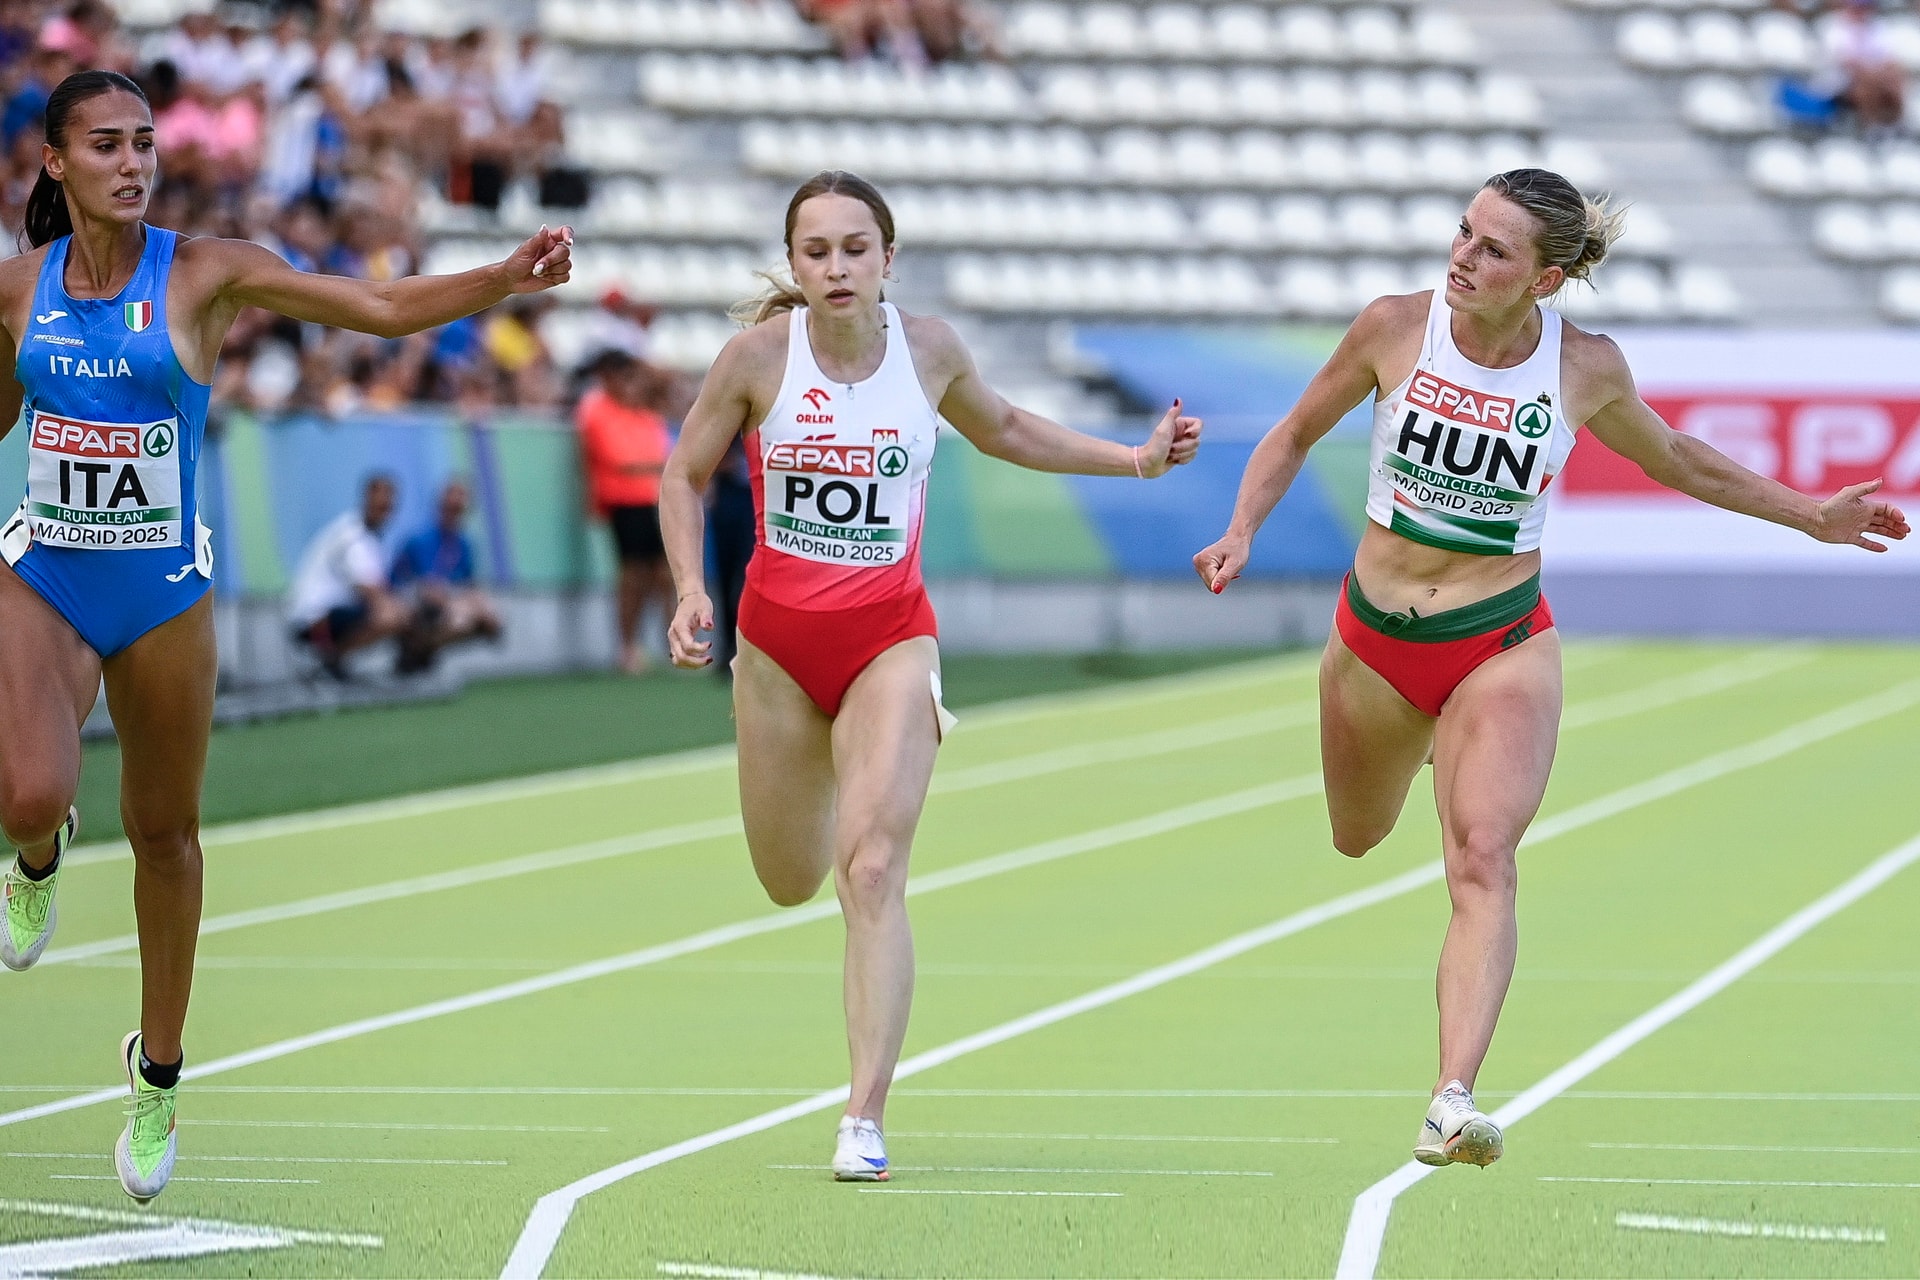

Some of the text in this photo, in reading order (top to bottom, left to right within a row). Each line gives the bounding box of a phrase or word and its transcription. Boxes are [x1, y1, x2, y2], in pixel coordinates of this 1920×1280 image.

[50, 355, 133, 378] ITALIA
[1410, 376, 1511, 427] SPAR
[796, 414, 833, 424] ORLEN
[36, 420, 137, 454] SPAR
[1397, 410, 1538, 490] HUN
[770, 447, 872, 473] SPAR
[59, 459, 150, 508] ITA
[1411, 465, 1416, 475] I
[1417, 469, 1449, 487] RUN
[785, 476, 890, 525] POL
[1394, 473, 1516, 515] MADRID 2025
[57, 508, 61, 519] I
[63, 509, 93, 523] RUN
[791, 519, 797, 528] I
[798, 521, 825, 536] RUN
[37, 522, 117, 544] MADRID
[121, 526, 168, 544] 2025
[776, 530, 894, 561] MADRID 2025
